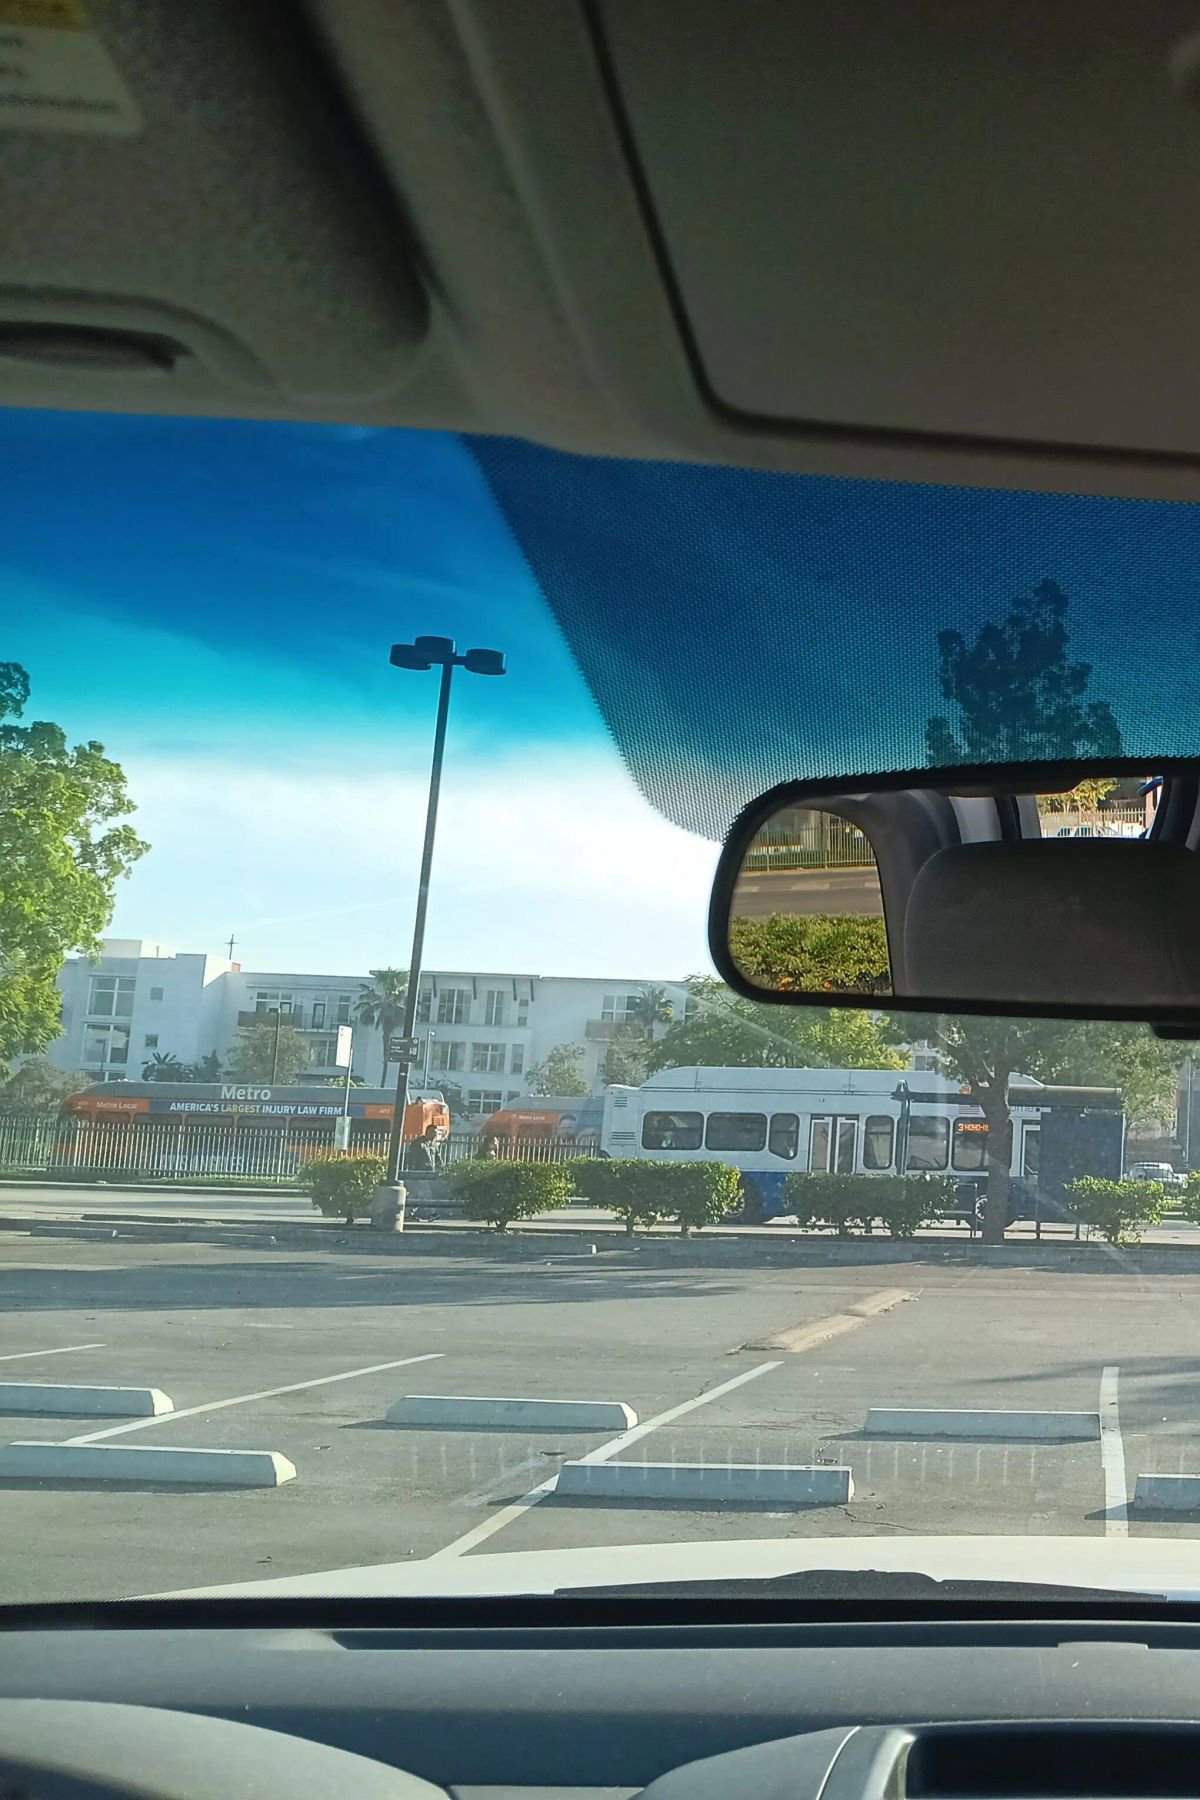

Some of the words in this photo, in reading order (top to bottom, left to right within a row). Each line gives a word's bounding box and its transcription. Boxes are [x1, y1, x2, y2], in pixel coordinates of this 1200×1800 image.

[221, 1085, 271, 1100] Metro
[96, 1101, 118, 1109] Metro
[169, 1103, 219, 1112] AMERICA'S
[221, 1104, 261, 1113] LARGEST
[262, 1105, 296, 1114] INJURY
[298, 1106, 319, 1114] LAW
[320, 1107, 343, 1115] FIRM
